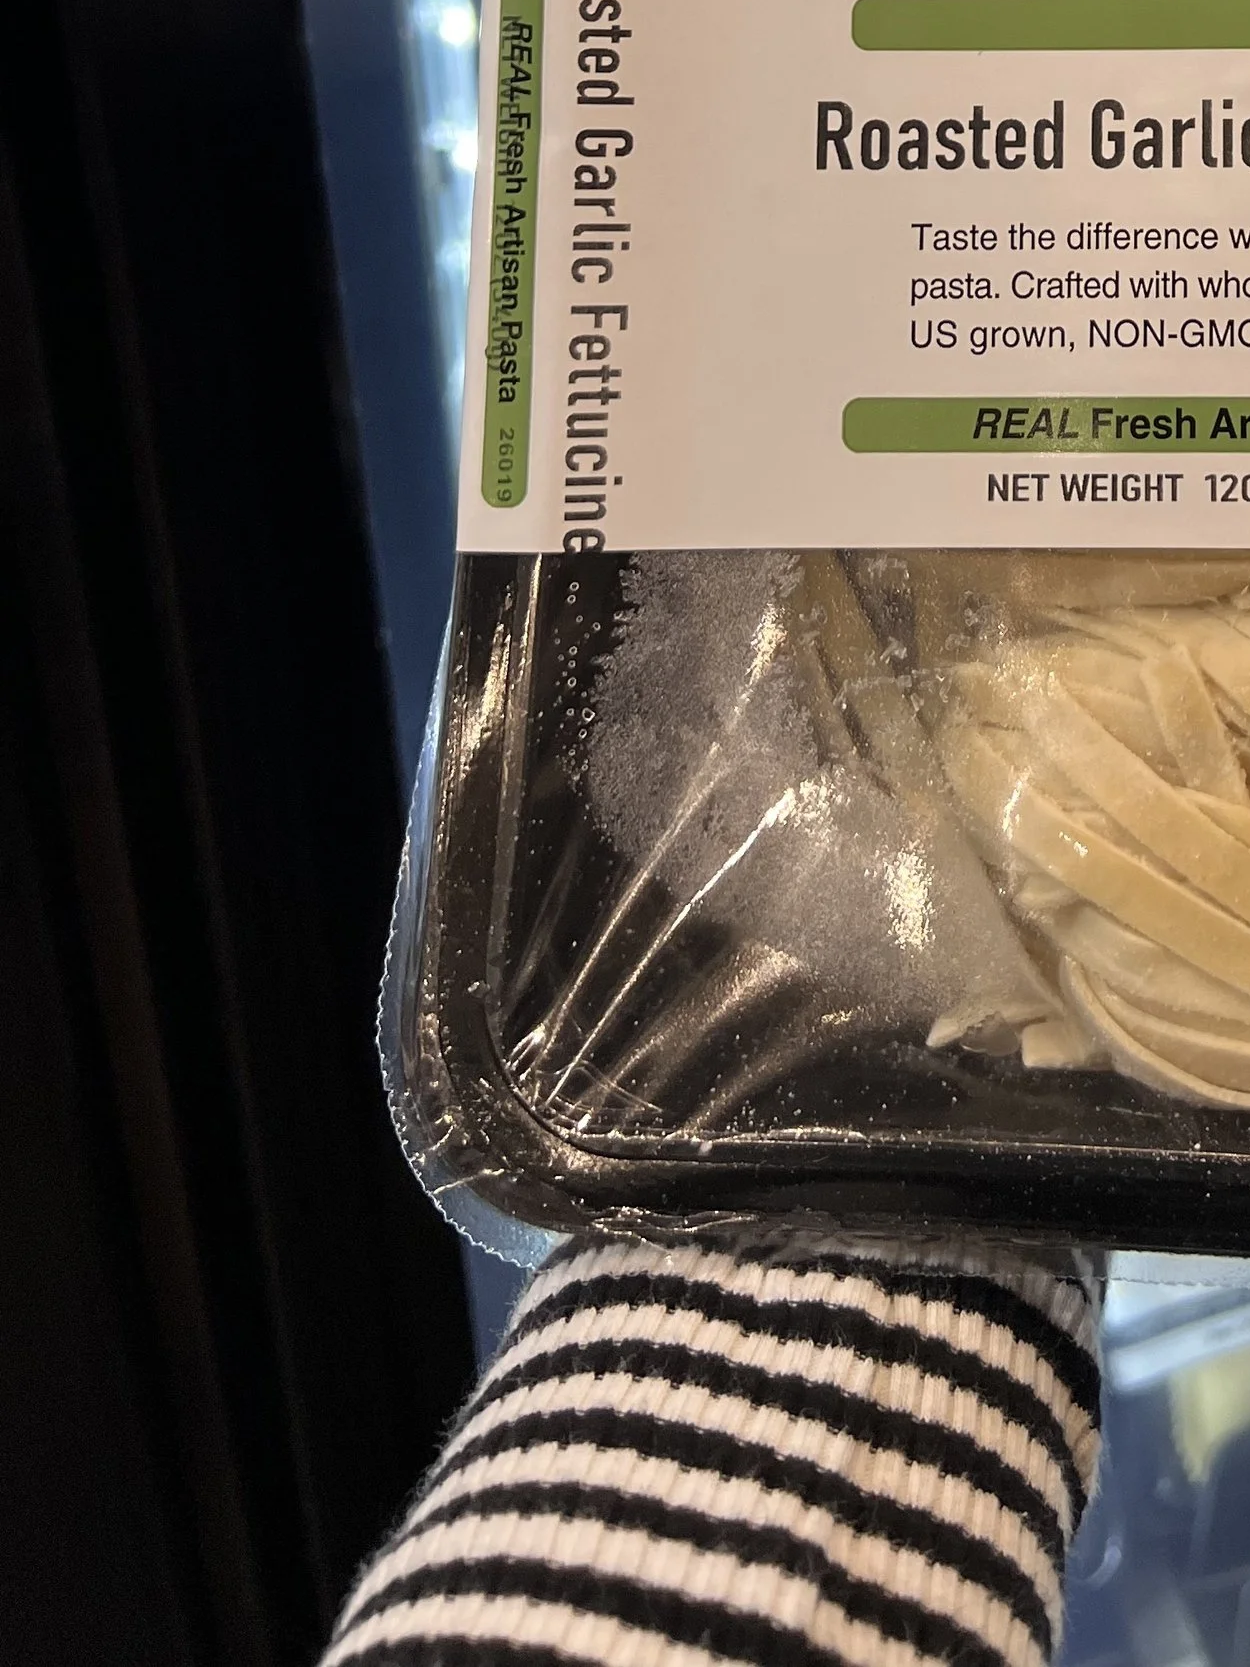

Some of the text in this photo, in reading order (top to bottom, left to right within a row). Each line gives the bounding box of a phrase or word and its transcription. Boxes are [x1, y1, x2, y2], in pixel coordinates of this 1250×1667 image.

[816, 100, 1064, 171] Roasted
[498, 21, 534, 403] REAL Fresh Artisan Pasta
[571, 128, 633, 284] Garlic
[911, 224, 997, 251] Taste
[1008, 223, 1055, 251] the
[1067, 222, 1218, 251] difference
[911, 273, 999, 306] pasta.
[1012, 271, 1119, 300] Crafted
[1129, 270, 1187, 299] with
[912, 320, 957, 349] US
[970, 327, 1075, 356] grown,
[563, 305, 628, 554] Fettucine
[973, 407, 1080, 440] REAL
[1092, 407, 1197, 440] Fresh
[497, 428, 515, 502] 26019
[987, 473, 1050, 502] NET
[1061, 473, 1183, 502] WEIGHT
